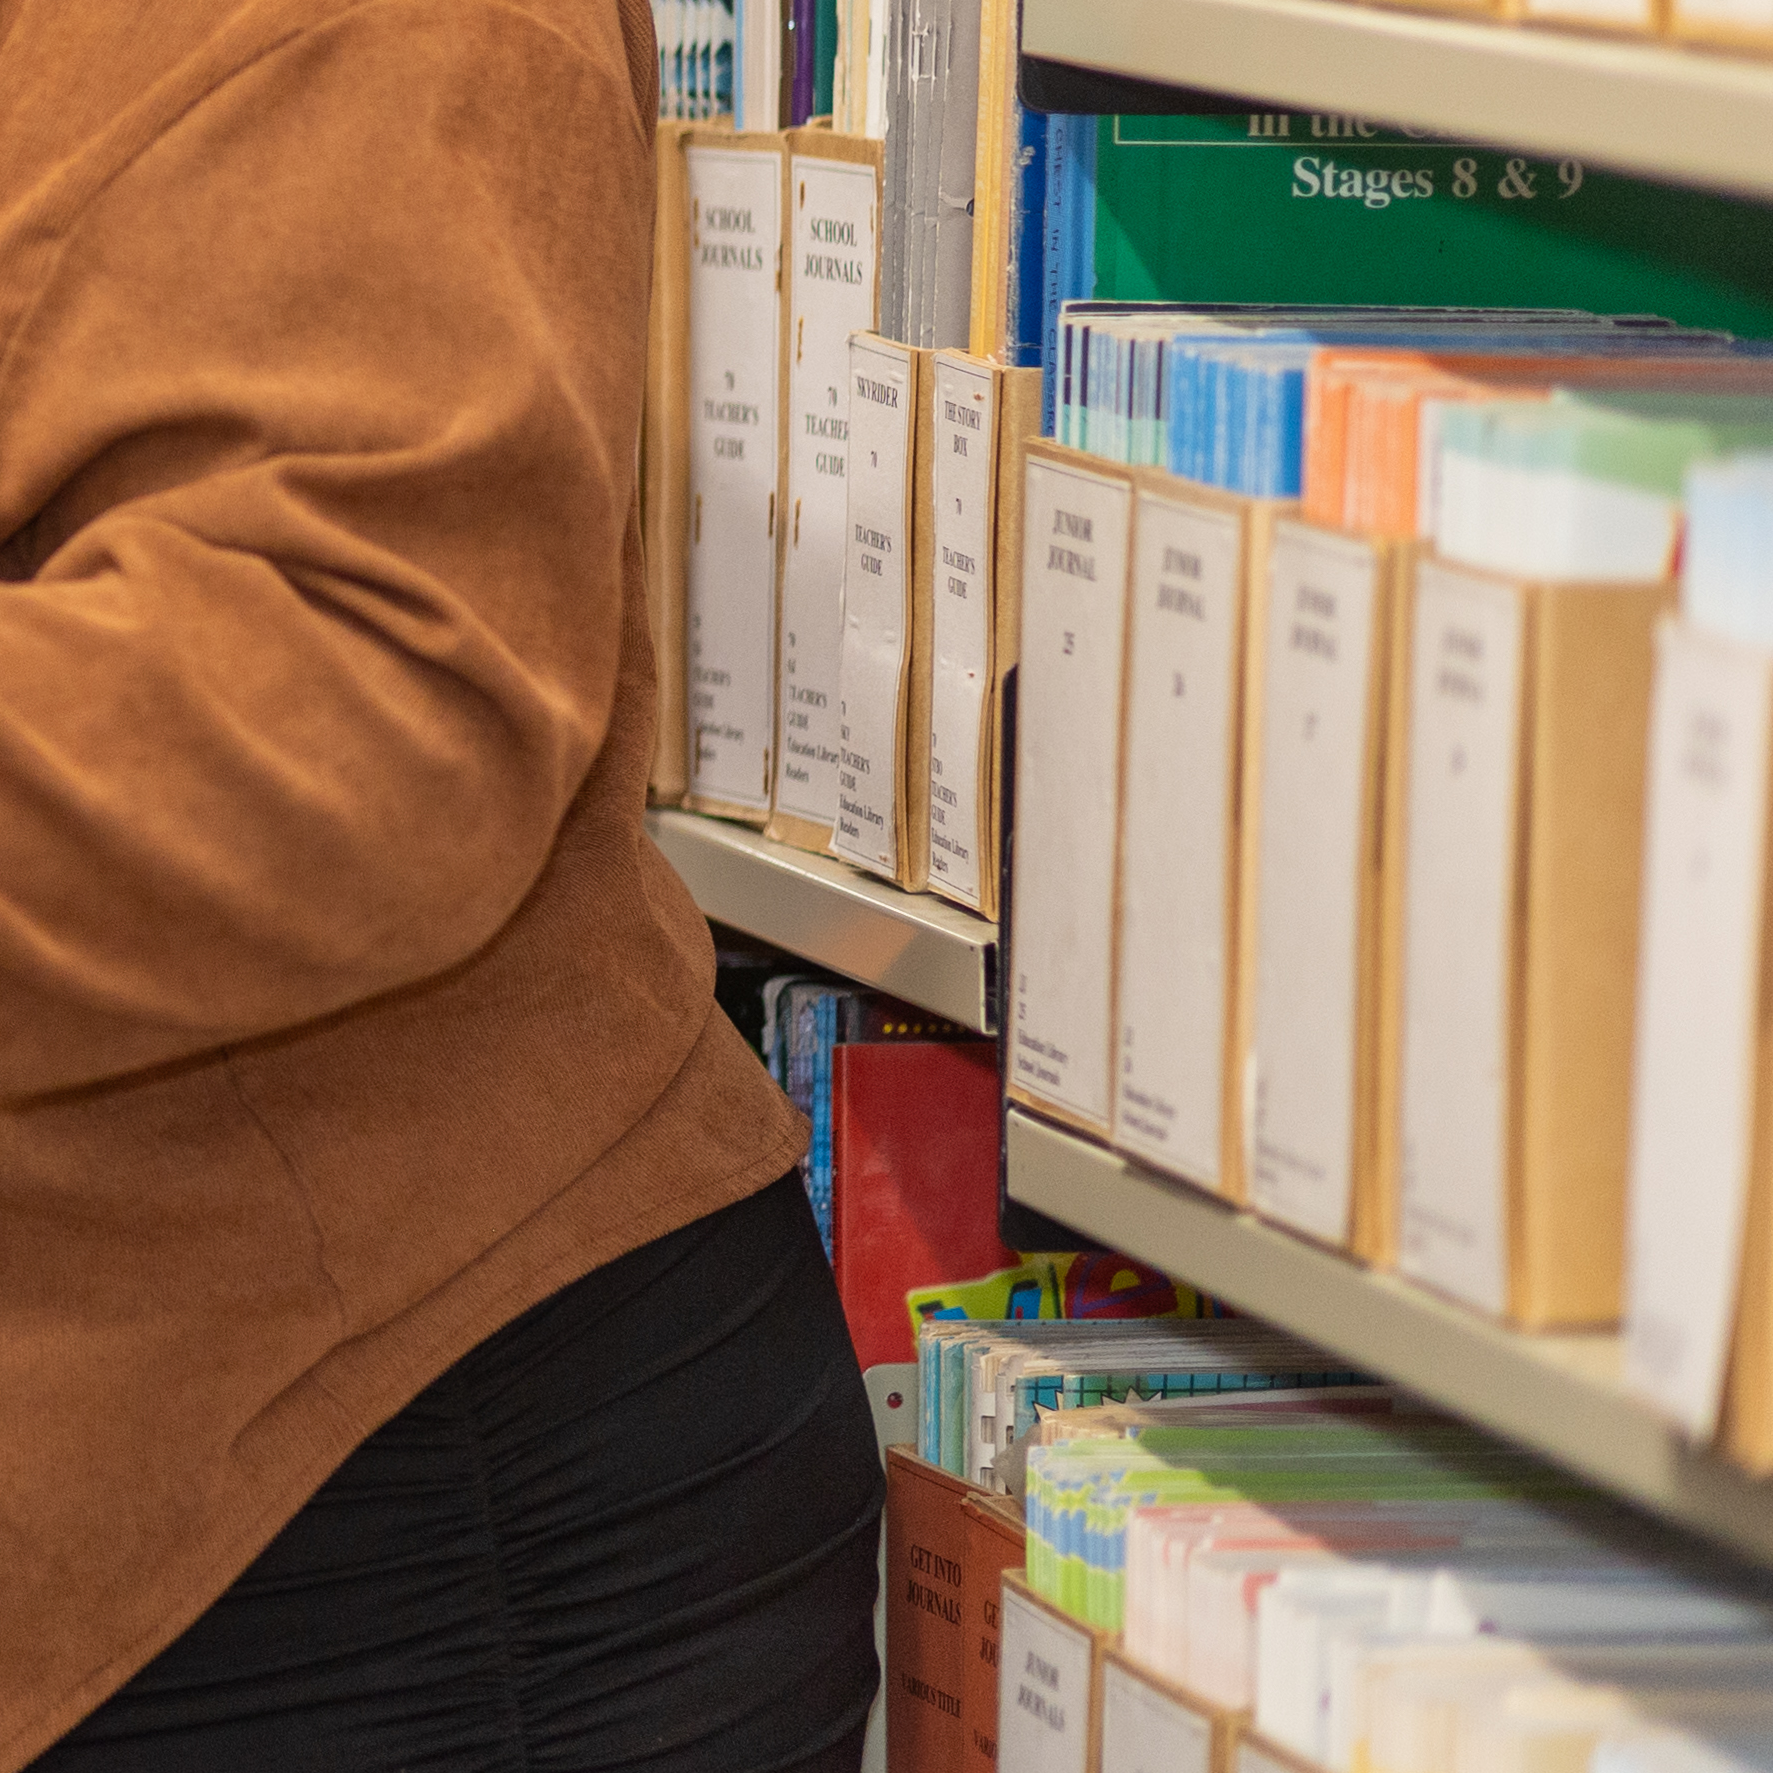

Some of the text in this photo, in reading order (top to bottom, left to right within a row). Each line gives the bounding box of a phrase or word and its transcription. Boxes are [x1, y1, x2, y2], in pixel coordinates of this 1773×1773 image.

[1291, 156, 1584, 209] Stages 8 & 9
[705, 206, 755, 234] SCHOOL
[810, 217, 857, 247] SCHOOL
[702, 242, 763, 271] JOURNALS
[805, 252, 863, 285] JOURNALS
[828, 386, 837, 408] 70
[857, 376, 898, 409] SKYRIDER
[945, 400, 982, 431] THE STORY
[953, 434, 968, 457] BOX
[816, 451, 845, 478] GUIDE
[855, 524, 892, 553] TEACHER'S
[861, 554, 883, 577] GUIDE
[943, 546, 975, 575] TEACHER'S
[948, 576, 968, 599] GUIDE
[840, 747, 870, 775] TEACHER'S
[840, 794, 884, 830] Education Library
[840, 817, 860, 839] Readers
[932, 828, 969, 864] Education Library
[910, 1544, 962, 1589] GET INTO
[907, 1579, 962, 1626] JOURNALS
